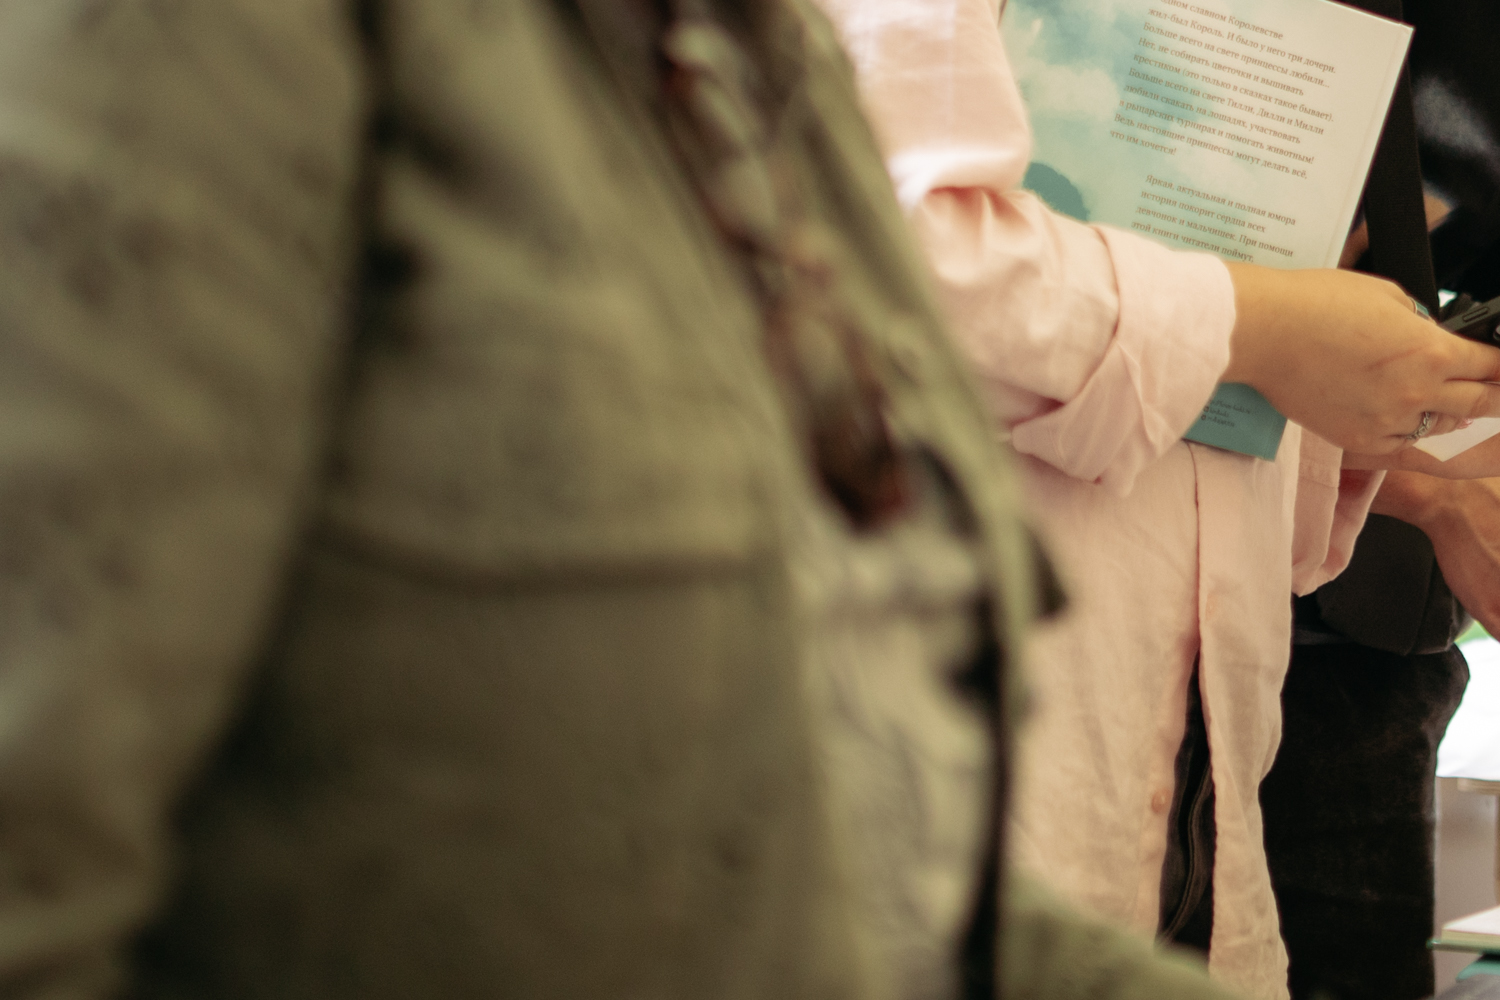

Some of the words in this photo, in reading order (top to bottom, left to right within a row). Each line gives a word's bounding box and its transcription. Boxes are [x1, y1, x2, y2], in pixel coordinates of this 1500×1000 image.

[1142, 21, 1178, 40] Больше
[1178, 34, 1203, 47] всего
[1203, 42, 1215, 52] на
[1215, 46, 1240, 59] свете
[1240, 54, 1289, 75] принцессы
[1147, 8, 1189, 27] жил-был
[1189, 19, 1224, 38] Король.
[1234, 34, 1259, 48] было
[1265, 45, 1286, 57] него
[1287, 52, 1303, 63] три
[1302, 57, 1335, 73] дочери.
[1188, 4, 1227, 22] славном
[1227, 14, 1283, 40] Королевстве
[1132, 53, 1181, 74] крестиком
[1200, 74, 1231, 89] только
[1238, 86, 1273, 102] сказках
[1273, 97, 1298, 110] такое
[1137, 36, 1156, 50] Нет,
[1157, 44, 1169, 54] не
[1169, 49, 1210, 66] собирать
[1210, 61, 1252, 80] цветочки
[1259, 76, 1304, 96] вышивать
[1123, 84, 1159, 101] любили
[1159, 95, 1194, 111] скакать
[1195, 106, 1207, 115] на
[1206, 110, 1247, 128] лошадях,
[1248, 122, 1301, 144] участвовать
[1127, 66, 1164, 85] Больше
[1163, 79, 1189, 93] всего
[1188, 87, 1201, 97] на
[1201, 92, 1226, 104] свете
[1226, 97, 1255, 114] Тилли,
[1255, 107, 1286, 123] Дилли
[1293, 118, 1324, 135] Милли
[1109, 129, 1125, 140] что
[1125, 134, 1139, 144] им
[1138, 139, 1177, 155] хочется!
[1113, 112, 1135, 126] Ведь
[1135, 121, 1185, 141] настоящие
[1185, 136, 1234, 156] принцессы
[1234, 151, 1261, 164] могут
[1260, 159, 1290, 173] делать
[1290, 168, 1307, 179] всё,
[1124, 101, 1174, 122] рыцарских
[1175, 116, 1216, 135] турнирах
[1224, 131, 1264, 149] помогать
[1265, 144, 1314, 164] животным!
[1140, 190, 1177, 207] история
[1177, 201, 1215, 218] покорит
[1215, 212, 1246, 227] сердца
[1246, 221, 1266, 233] всех
[1144, 174, 1174, 190] Яркая,
[1175, 184, 1226, 205] актуальная
[1234, 201, 1266, 217] полная
[1266, 211, 1296, 225] юмора
[1130, 221, 1151, 232] этой
[1151, 227, 1179, 240] книги
[1180, 235, 1220, 252] читатели
[1220, 246, 1253, 262] поймут,
[1135, 206, 1178, 223] девчонок
[1185, 220, 1236, 240] мальчишек.
[1238, 233, 1257, 247] При
[1257, 241, 1293, 257] помощи
